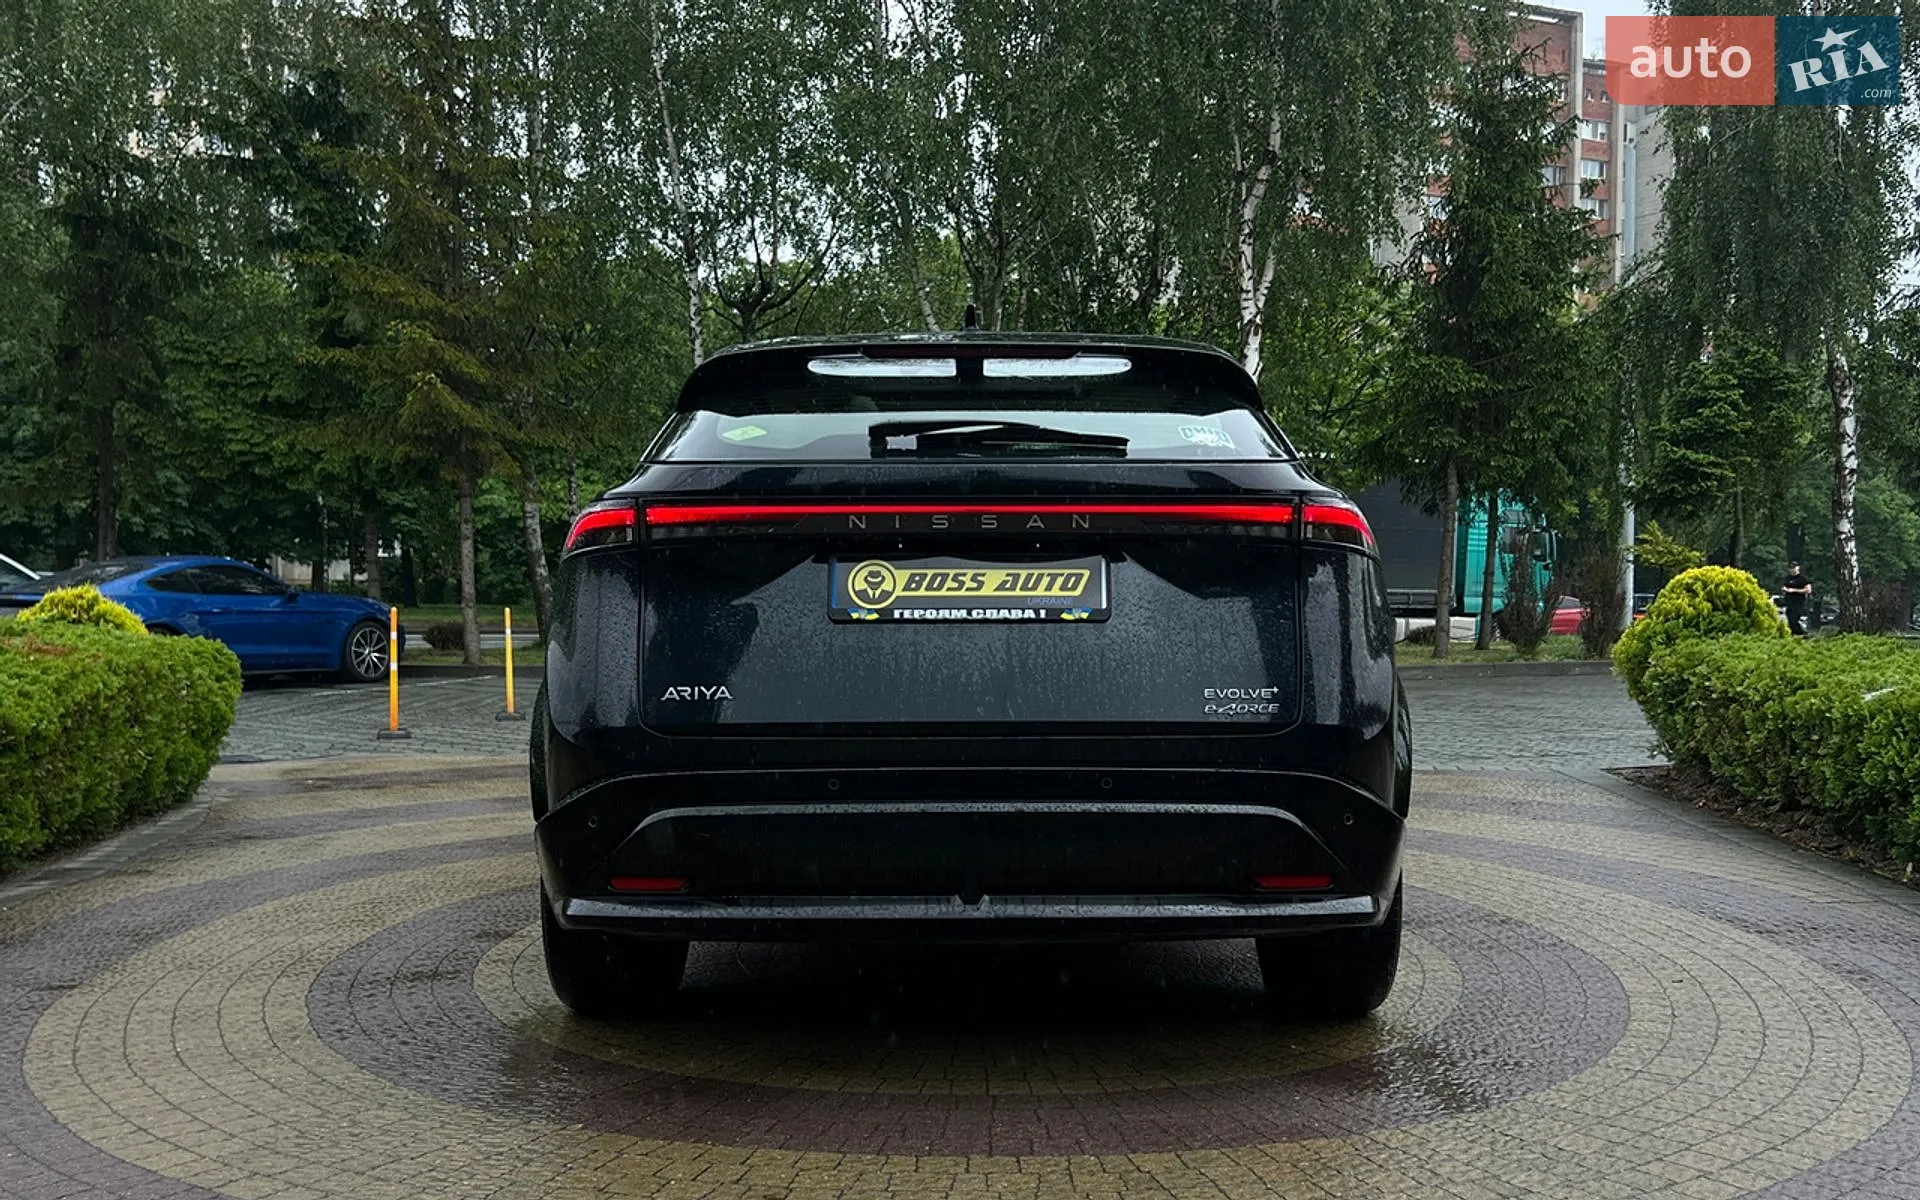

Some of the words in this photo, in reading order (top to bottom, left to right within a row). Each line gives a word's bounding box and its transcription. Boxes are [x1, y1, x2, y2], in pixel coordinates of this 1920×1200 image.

[849, 515, 1089, 528] NISSAN
[902, 572, 986, 592] BOSS
[993, 572, 1084, 592] AUTO
[1027, 597, 1073, 605] UKRAINE
[893, 608, 966, 619] ГЕРОЯМ
[971, 608, 1036, 619] СЛАВА
[660, 686, 733, 700] ARIYA
